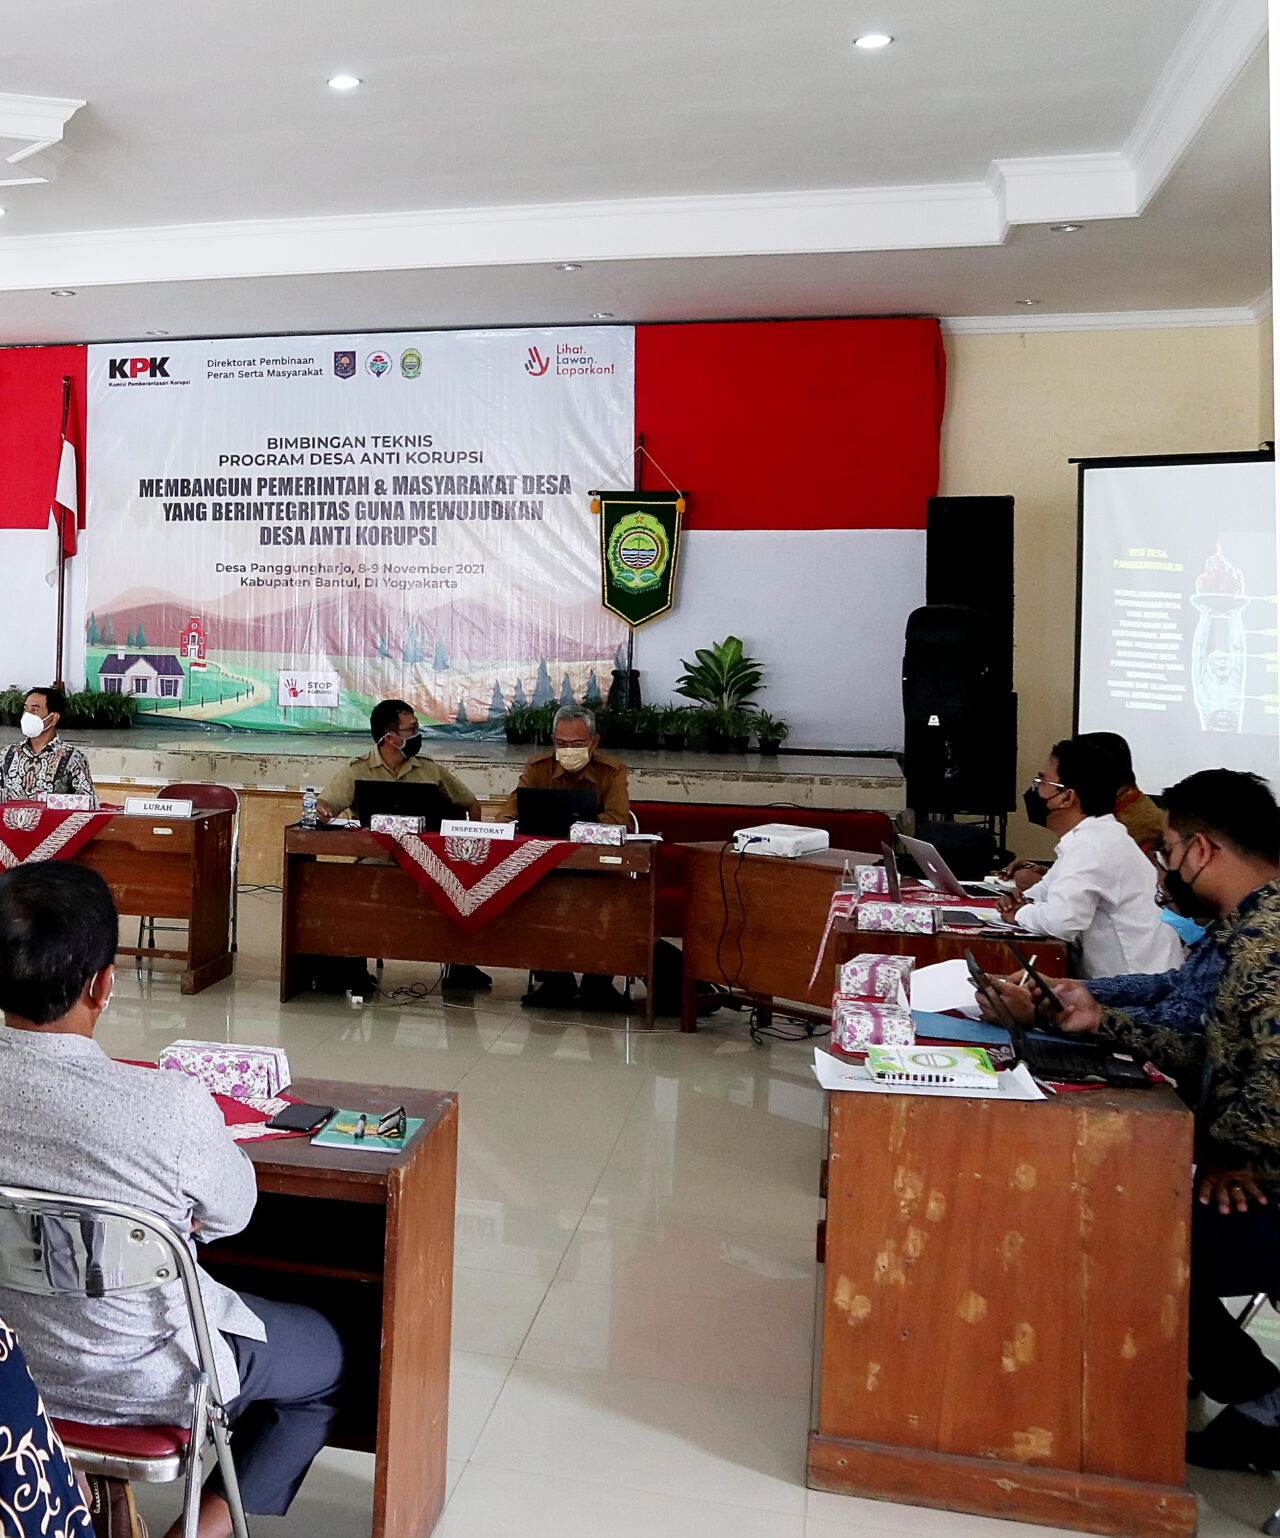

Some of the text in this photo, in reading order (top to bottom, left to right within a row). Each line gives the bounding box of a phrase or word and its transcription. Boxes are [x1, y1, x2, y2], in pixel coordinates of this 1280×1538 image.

[556, 344, 586, 354] Lihat.
[207, 356, 315, 368] Direktorat Pembinaan
[556, 355, 597, 364] Lawan.
[109, 357, 170, 379] KPK
[207, 367, 323, 380] Peran Serta Masyarakat
[556, 364, 615, 378] Laporkan!
[267, 435, 433, 450] BIMBINGAN TEKNIS
[219, 451, 483, 467] PROGRAM DESA ANTI KORUPSI
[139, 475, 572, 498] MEMBANGUN PEMERINTAH & MASYARAKAT DESA
[162, 500, 544, 521] YANG BERINTEGRITAS GUNA MEWUJUDKAN
[260, 526, 437, 546] DESA ANTI KORUPSI
[1146, 548, 1168, 558] DESA
[215, 562, 485, 575] Desa Panggungharjo, 8-9 November 2021
[240, 576, 458, 590] Kabupaten Bantul, DI Yogyakarta
[307, 681, 333, 689] STOP
[143, 803, 173, 811] LURAH
[451, 826, 504, 834] INSPEKTORAT
